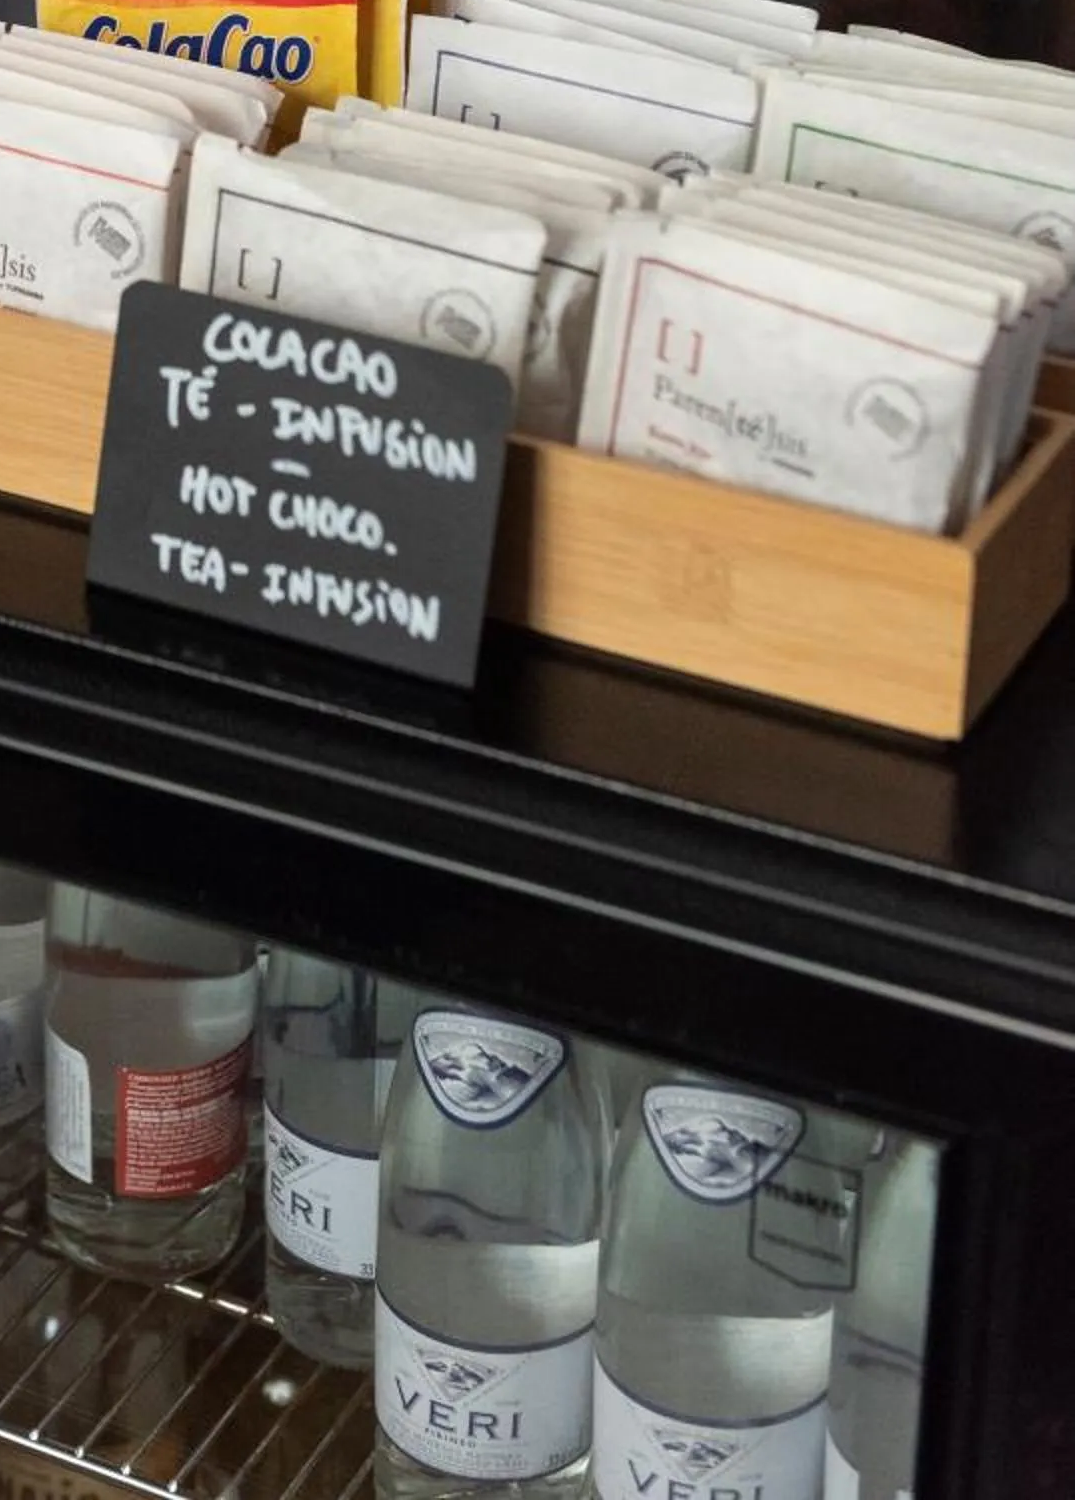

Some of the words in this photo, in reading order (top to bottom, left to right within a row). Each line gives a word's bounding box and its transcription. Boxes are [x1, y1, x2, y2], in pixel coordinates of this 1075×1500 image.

[84, 12, 313, 85] laCao
[180, 464, 258, 517] HOT
[269, 1170, 332, 1234] ERI
[393, 1376, 523, 1440] VERI
